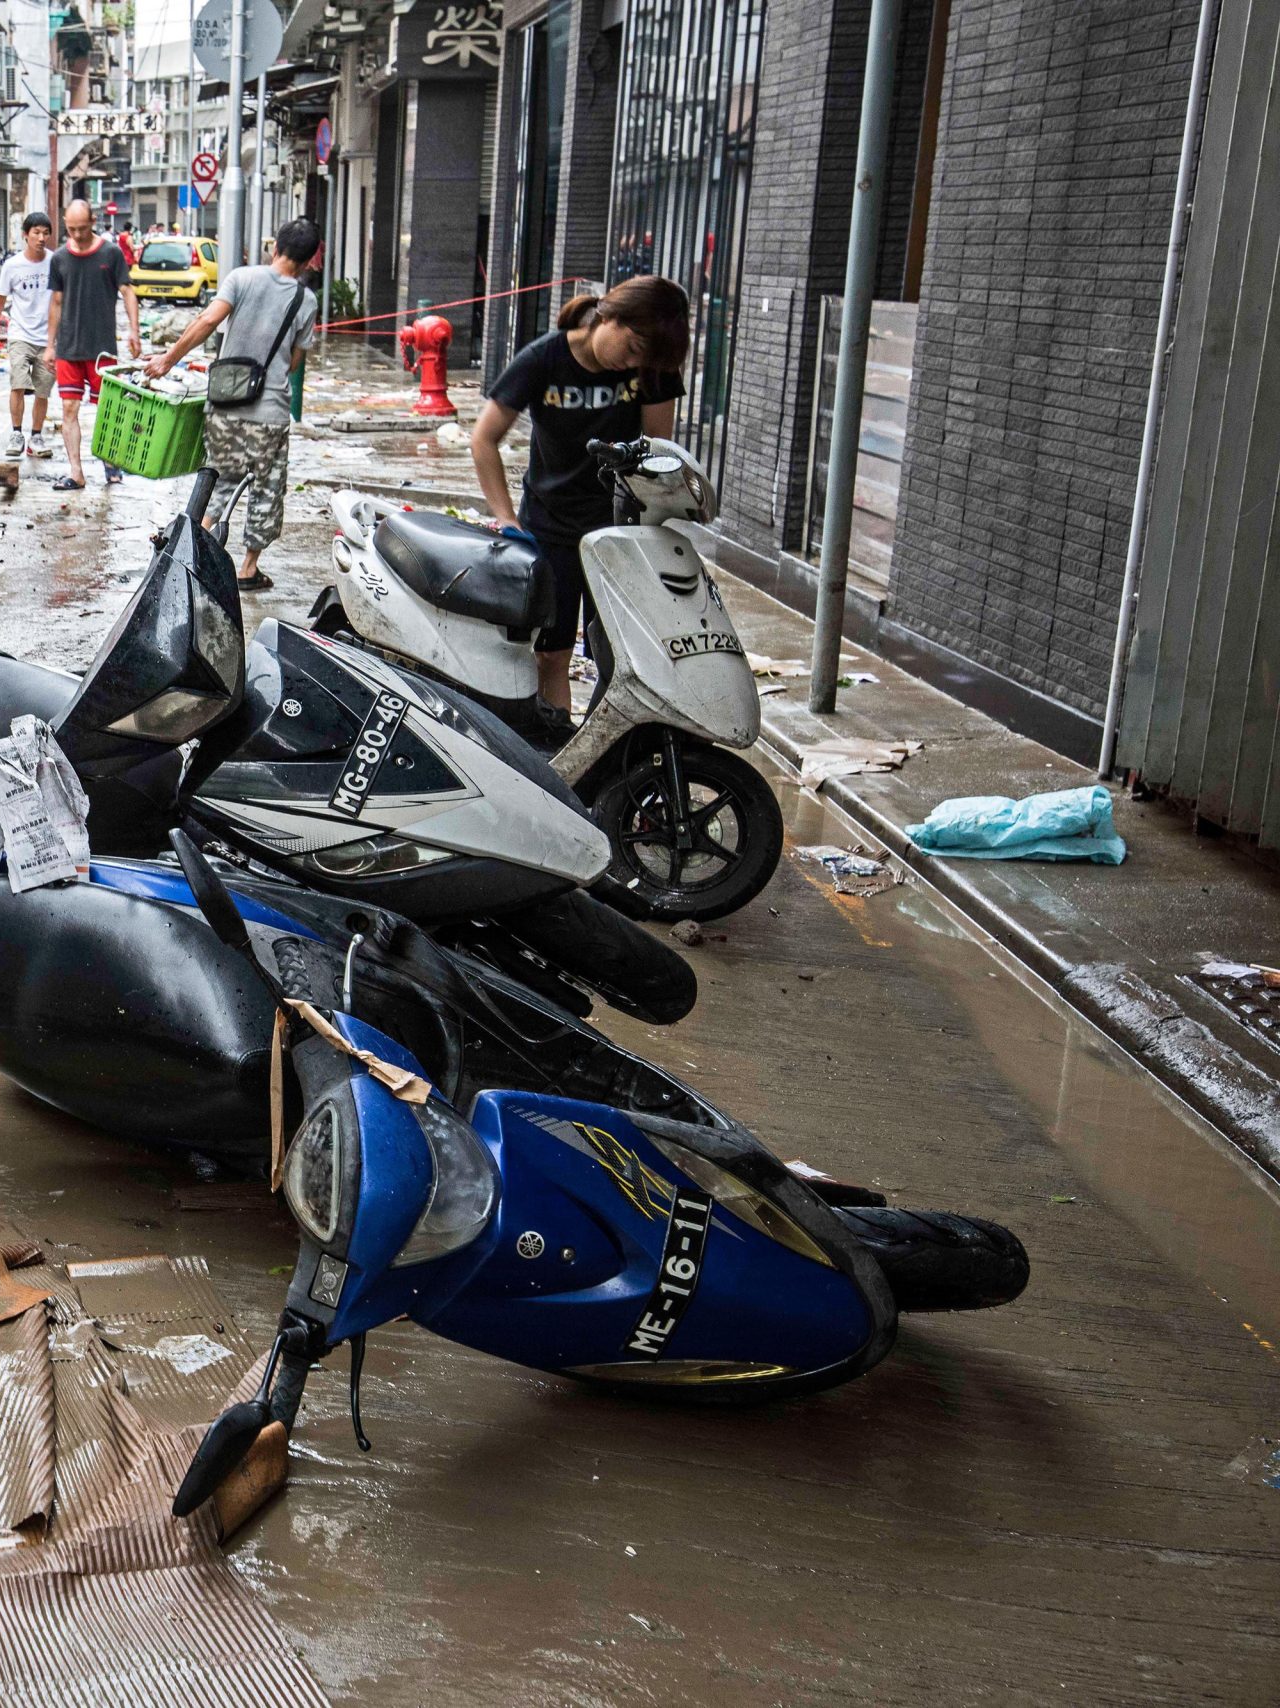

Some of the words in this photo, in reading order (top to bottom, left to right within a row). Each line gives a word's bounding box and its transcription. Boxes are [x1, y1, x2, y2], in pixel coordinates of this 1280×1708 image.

[422, 5, 501, 68] 榮
[670, 635, 697, 655] CM
[333, 694, 404, 813] MG-80-46
[628, 1197, 708, 1355] ME-16-11
